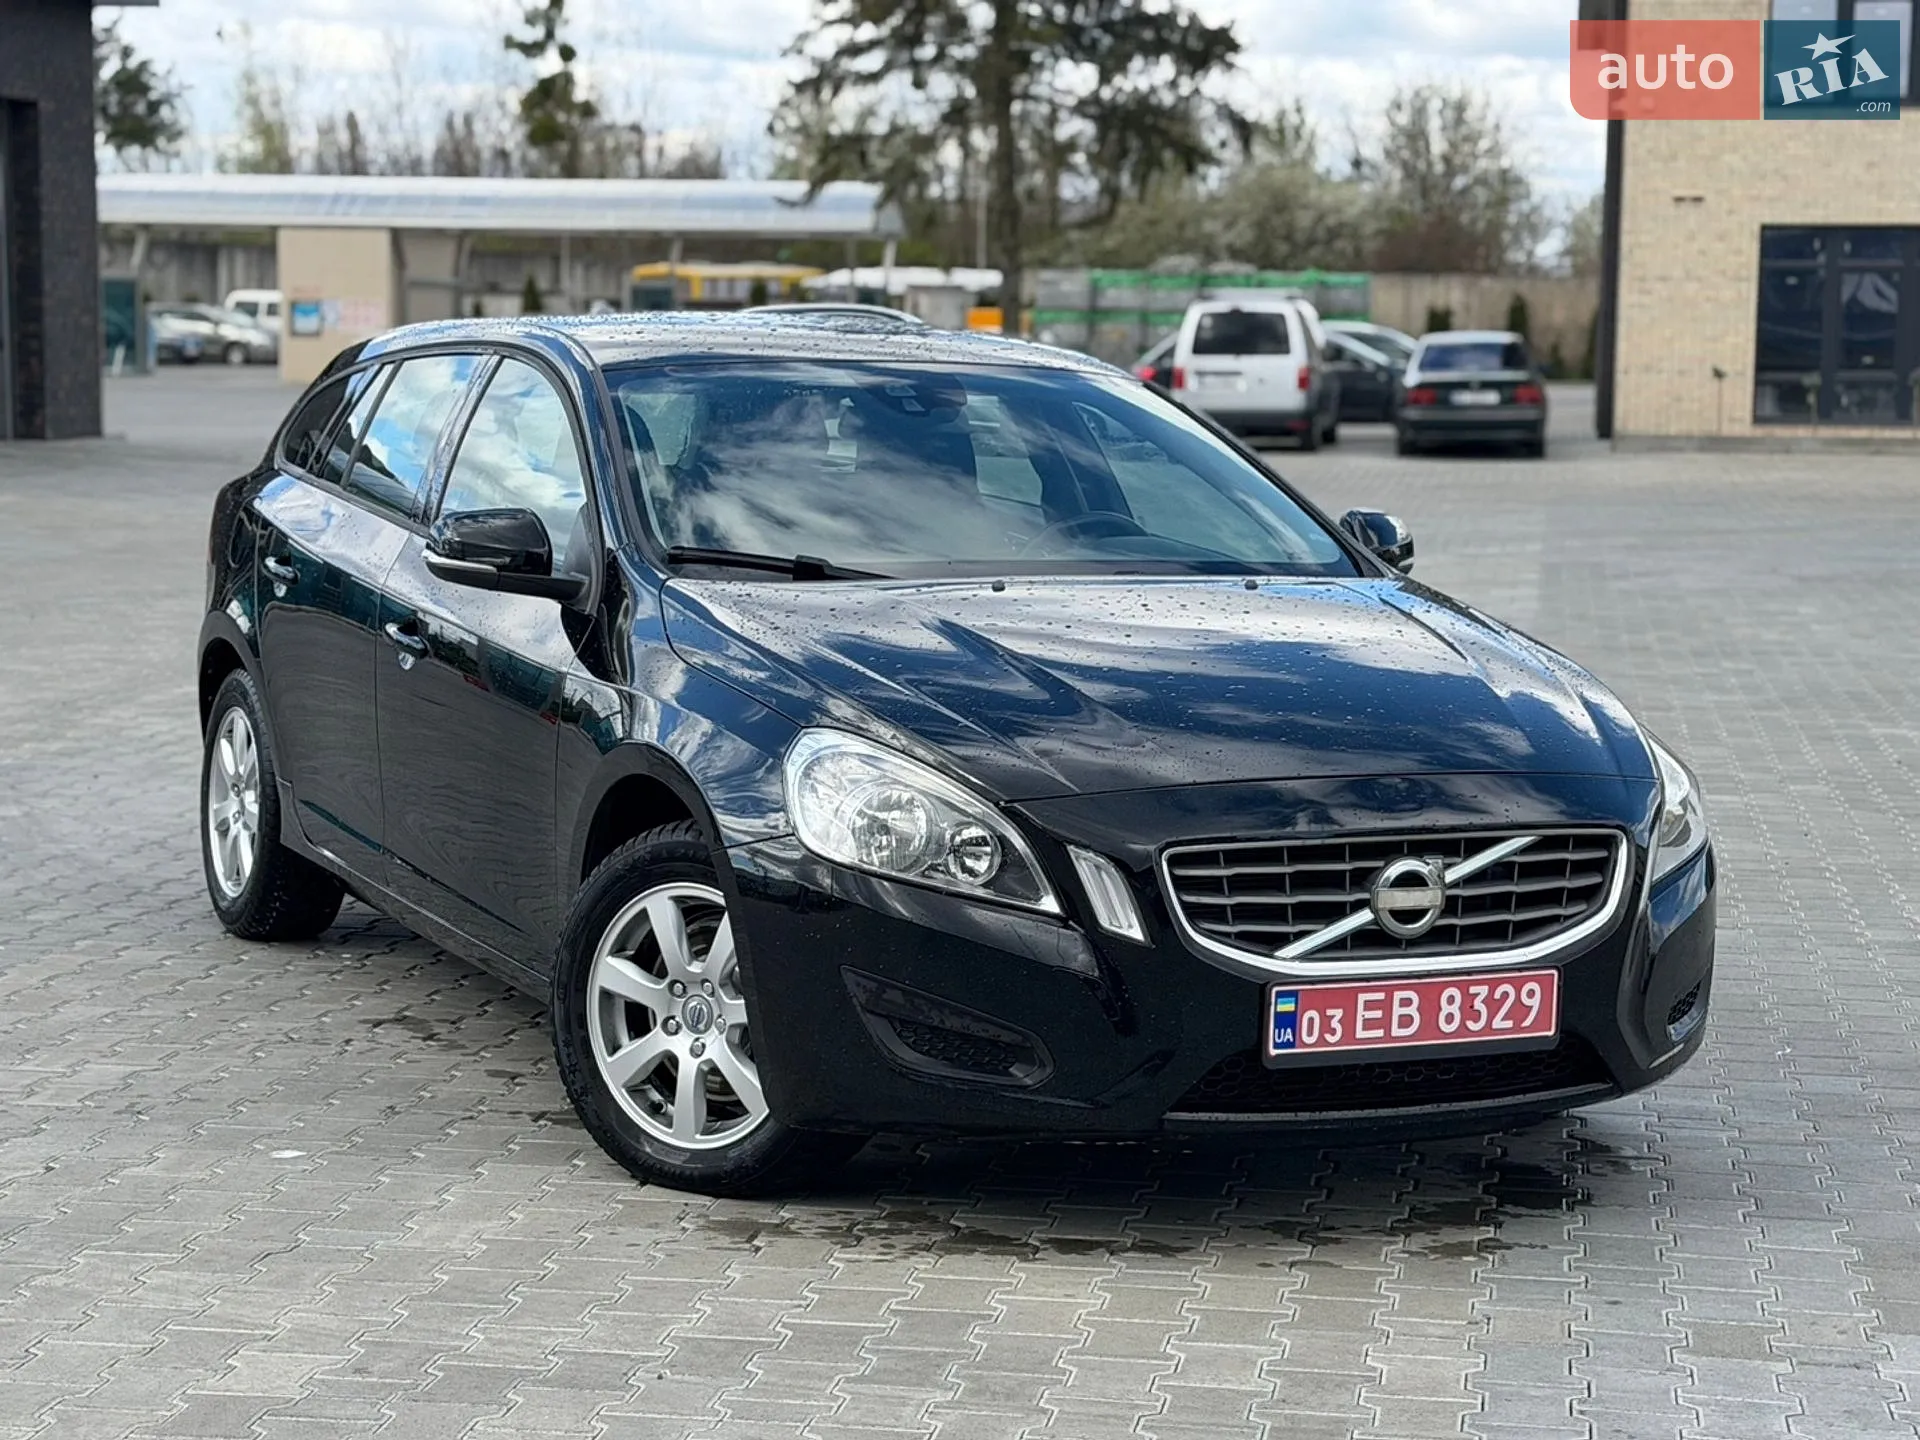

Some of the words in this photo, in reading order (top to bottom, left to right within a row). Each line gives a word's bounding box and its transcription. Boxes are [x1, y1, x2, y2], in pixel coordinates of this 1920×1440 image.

[1301, 1008, 1343, 1044] 03
[1355, 990, 1421, 1039] EB
[1438, 981, 1542, 1033] 8329
[1274, 1028, 1294, 1043] UA
